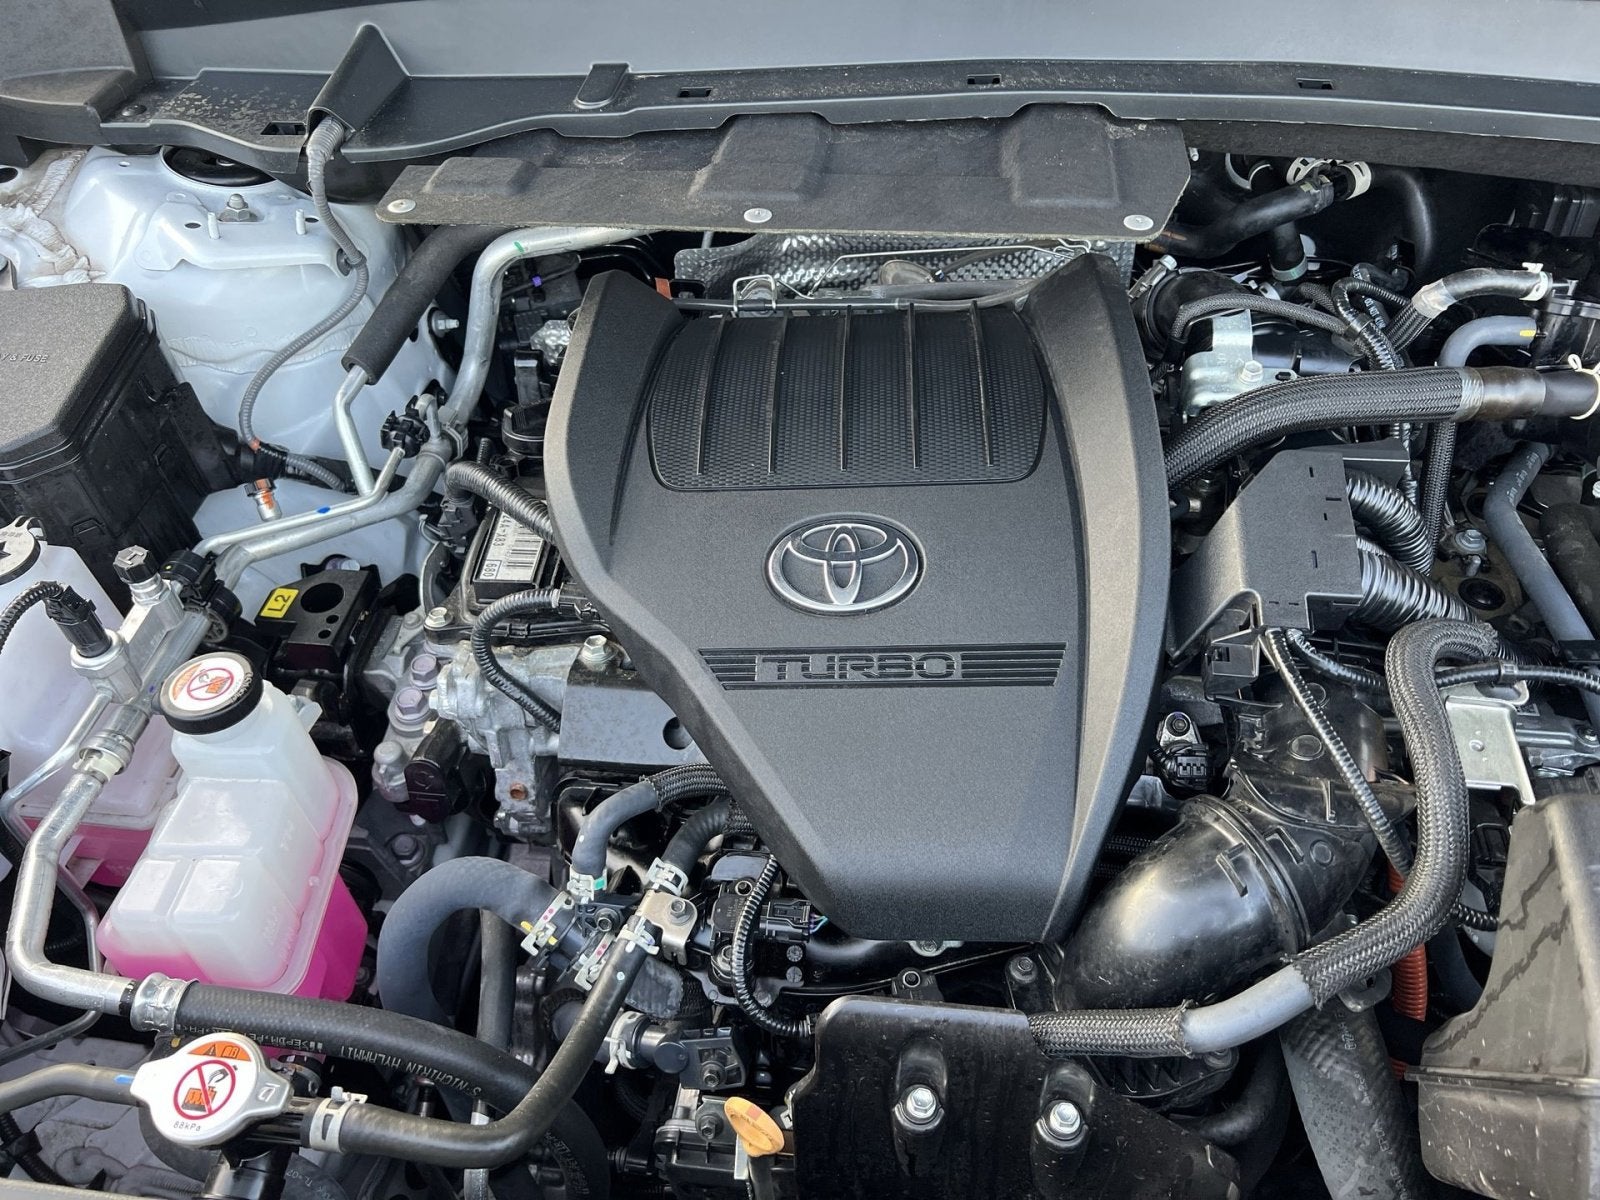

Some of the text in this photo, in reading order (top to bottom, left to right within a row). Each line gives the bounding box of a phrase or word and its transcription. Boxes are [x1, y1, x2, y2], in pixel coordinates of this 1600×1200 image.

[20, 353, 49, 363] FUSE
[267, 594, 292, 612] L2
[762, 652, 957, 681] TURBO
[173, 1120, 202, 1132] 88kPa
